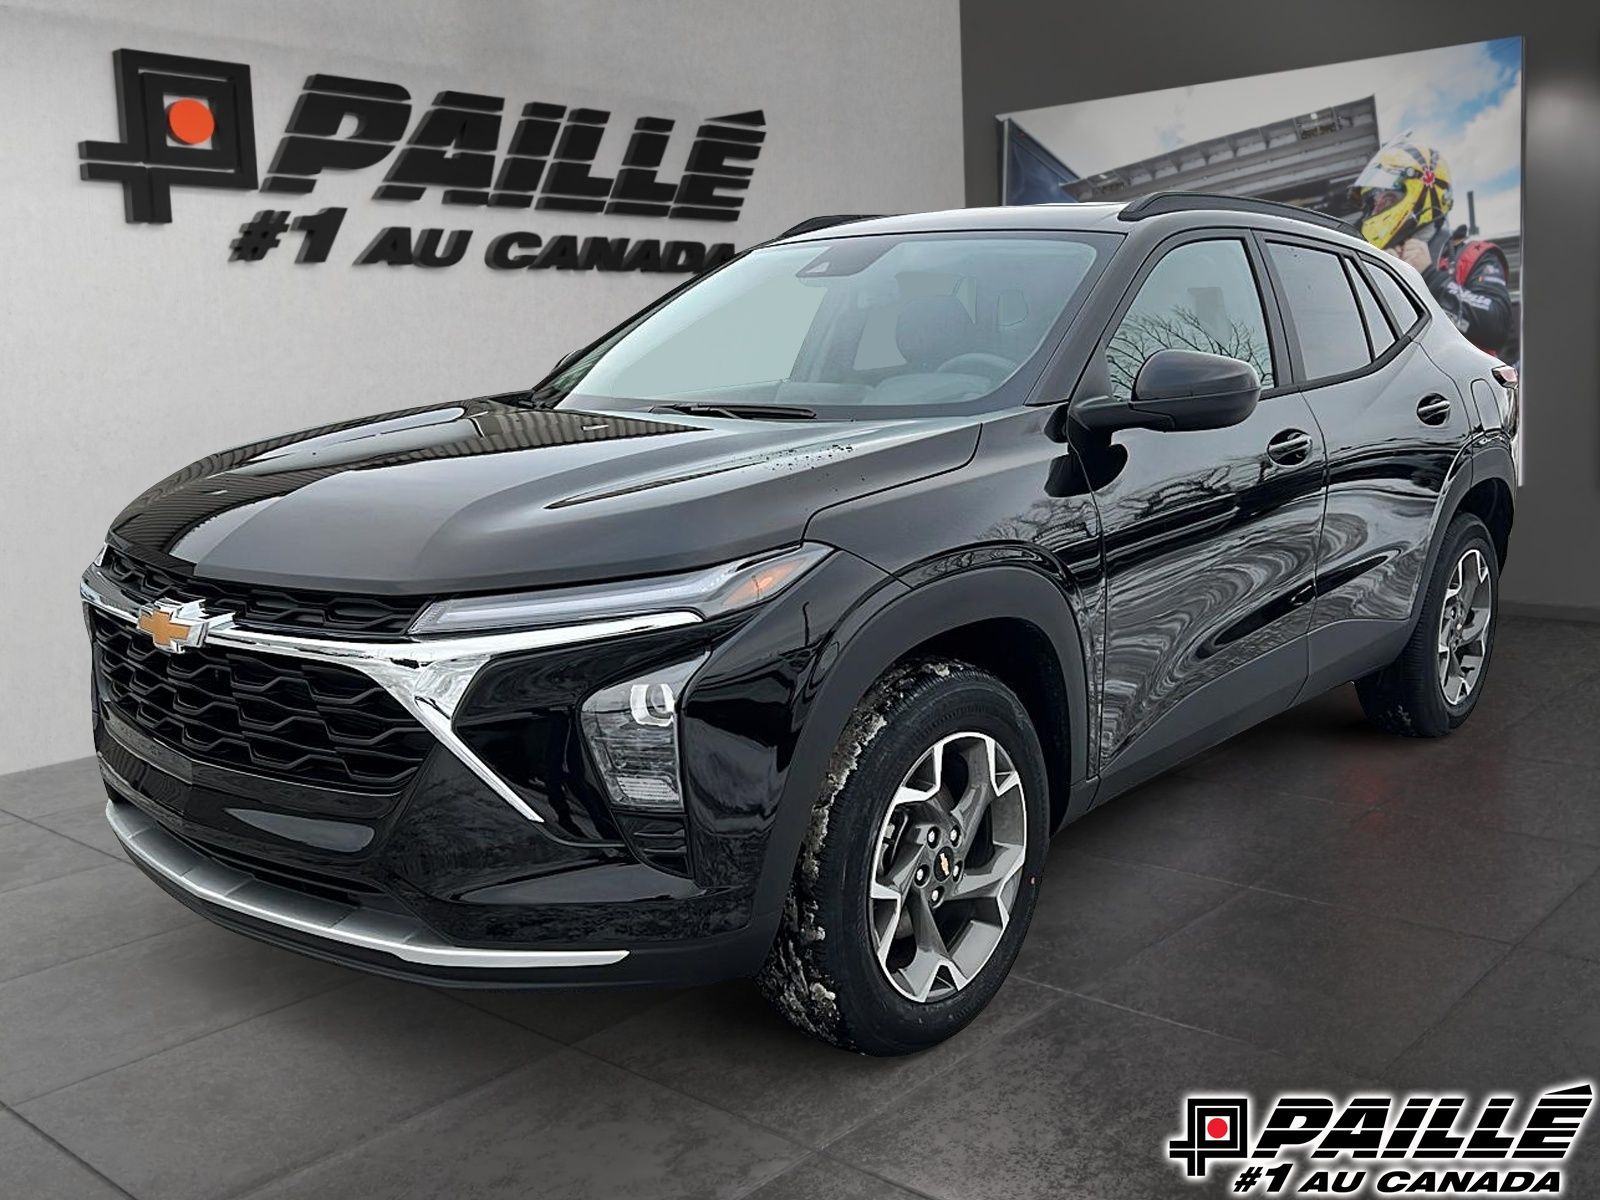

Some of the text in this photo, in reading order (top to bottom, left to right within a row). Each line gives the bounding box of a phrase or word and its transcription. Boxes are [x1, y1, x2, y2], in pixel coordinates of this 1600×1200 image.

[260, 73, 766, 222] PAILLÉ
[228, 206, 347, 265] #1
[353, 227, 473, 268] AU
